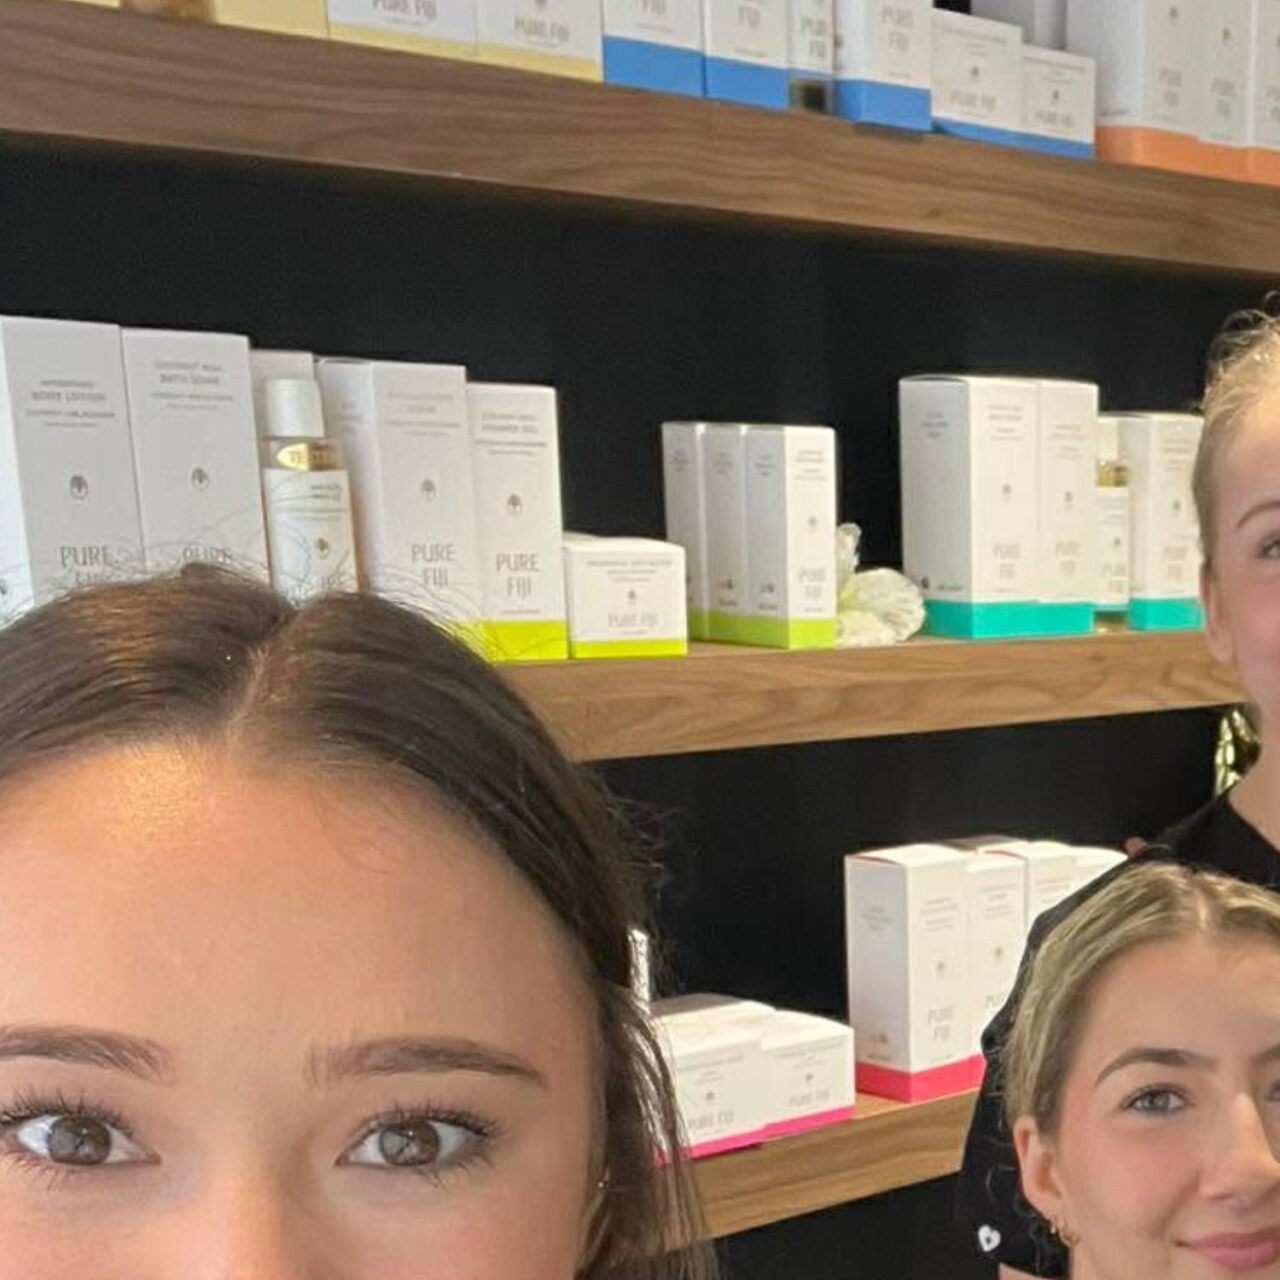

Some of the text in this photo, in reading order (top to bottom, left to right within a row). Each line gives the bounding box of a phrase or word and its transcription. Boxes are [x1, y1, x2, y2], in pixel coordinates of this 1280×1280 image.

[411, 543, 457, 563] PURE
[495, 552, 540, 573] PURE
[423, 567, 449, 590] FIJI
[507, 576, 533, 600] FIJI
